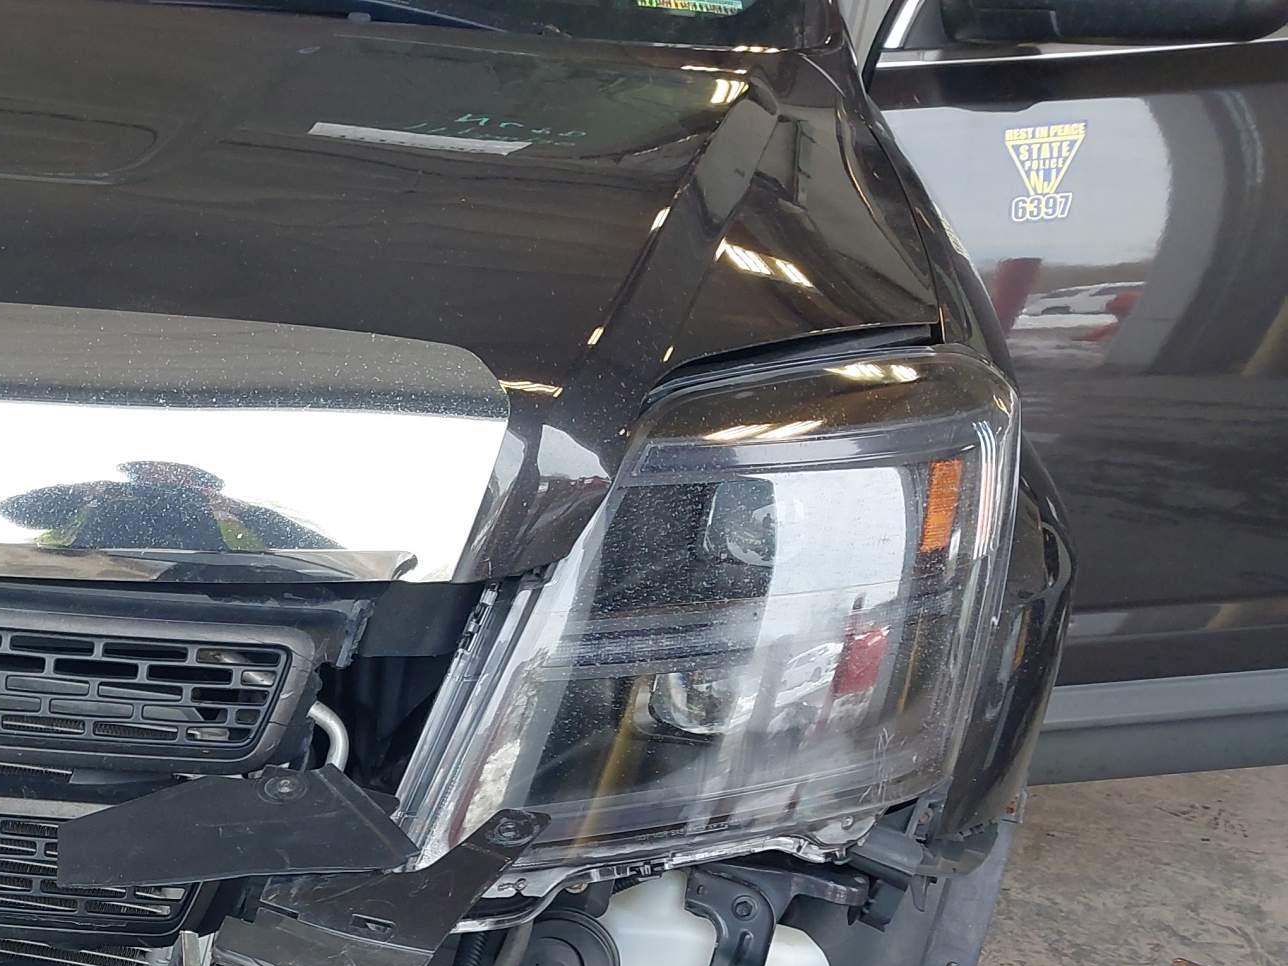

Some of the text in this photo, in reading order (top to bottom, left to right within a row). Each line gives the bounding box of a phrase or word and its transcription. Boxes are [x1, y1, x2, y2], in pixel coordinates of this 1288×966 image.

[1020, 142, 1070, 159] STATE
[1024, 159, 1064, 171] POLICE
[1030, 170, 1057, 193] NJ
[1013, 193, 1072, 221] 6397
